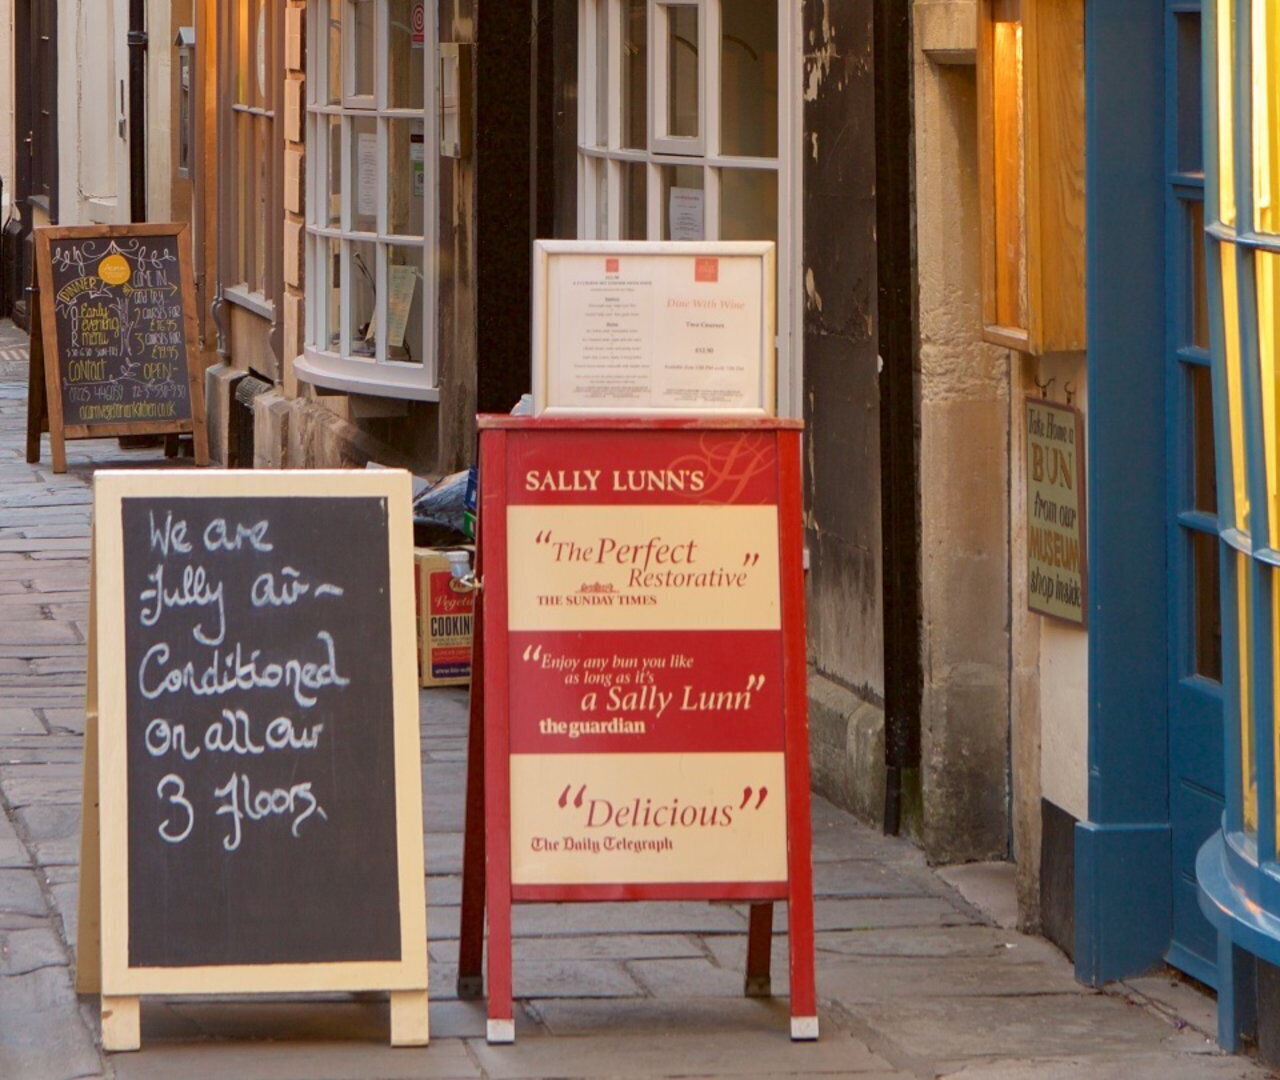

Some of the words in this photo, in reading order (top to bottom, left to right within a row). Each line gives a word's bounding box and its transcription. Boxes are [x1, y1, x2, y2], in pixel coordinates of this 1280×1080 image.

[59, 277, 97, 302] DINNER
[666, 297, 690, 309] Dine
[692, 297, 718, 309] With
[719, 298, 746, 310] Wine
[1046, 411, 1068, 442] Home
[526, 469, 602, 492] SALLY
[612, 469, 705, 492] LUNN'S
[1032, 442, 1073, 490] BUN
[1034, 490, 1057, 523] from
[1059, 505, 1077, 529] our
[148, 510, 193, 555] We
[204, 518, 274, 553] are
[1028, 525, 1080, 573] MUSEUM
[594, 536, 698, 572] Perfect
[537, 595, 563, 607] THE
[565, 595, 615, 607] SUNDAY
[617, 595, 658, 607] TIMES
[1031, 566, 1054, 604] shop
[431, 615, 473, 638] COOKIN
[138, 630, 350, 707] Conditioned
[565, 673, 579, 685] as
[583, 671, 612, 687] long
[615, 673, 631, 685] as
[635, 671, 655, 685] it's
[583, 655, 608, 671] any
[612, 654, 638, 669] bun
[641, 657, 666, 671] you
[670, 654, 695, 669] like
[581, 691, 598, 712] a
[606, 685, 673, 719] Sally
[204, 709, 264, 756] all
[157, 773, 195, 844] 3
[531, 836, 560, 851] The
[562, 836, 600, 853] Daily
[603, 835, 673, 853] Telegraph
